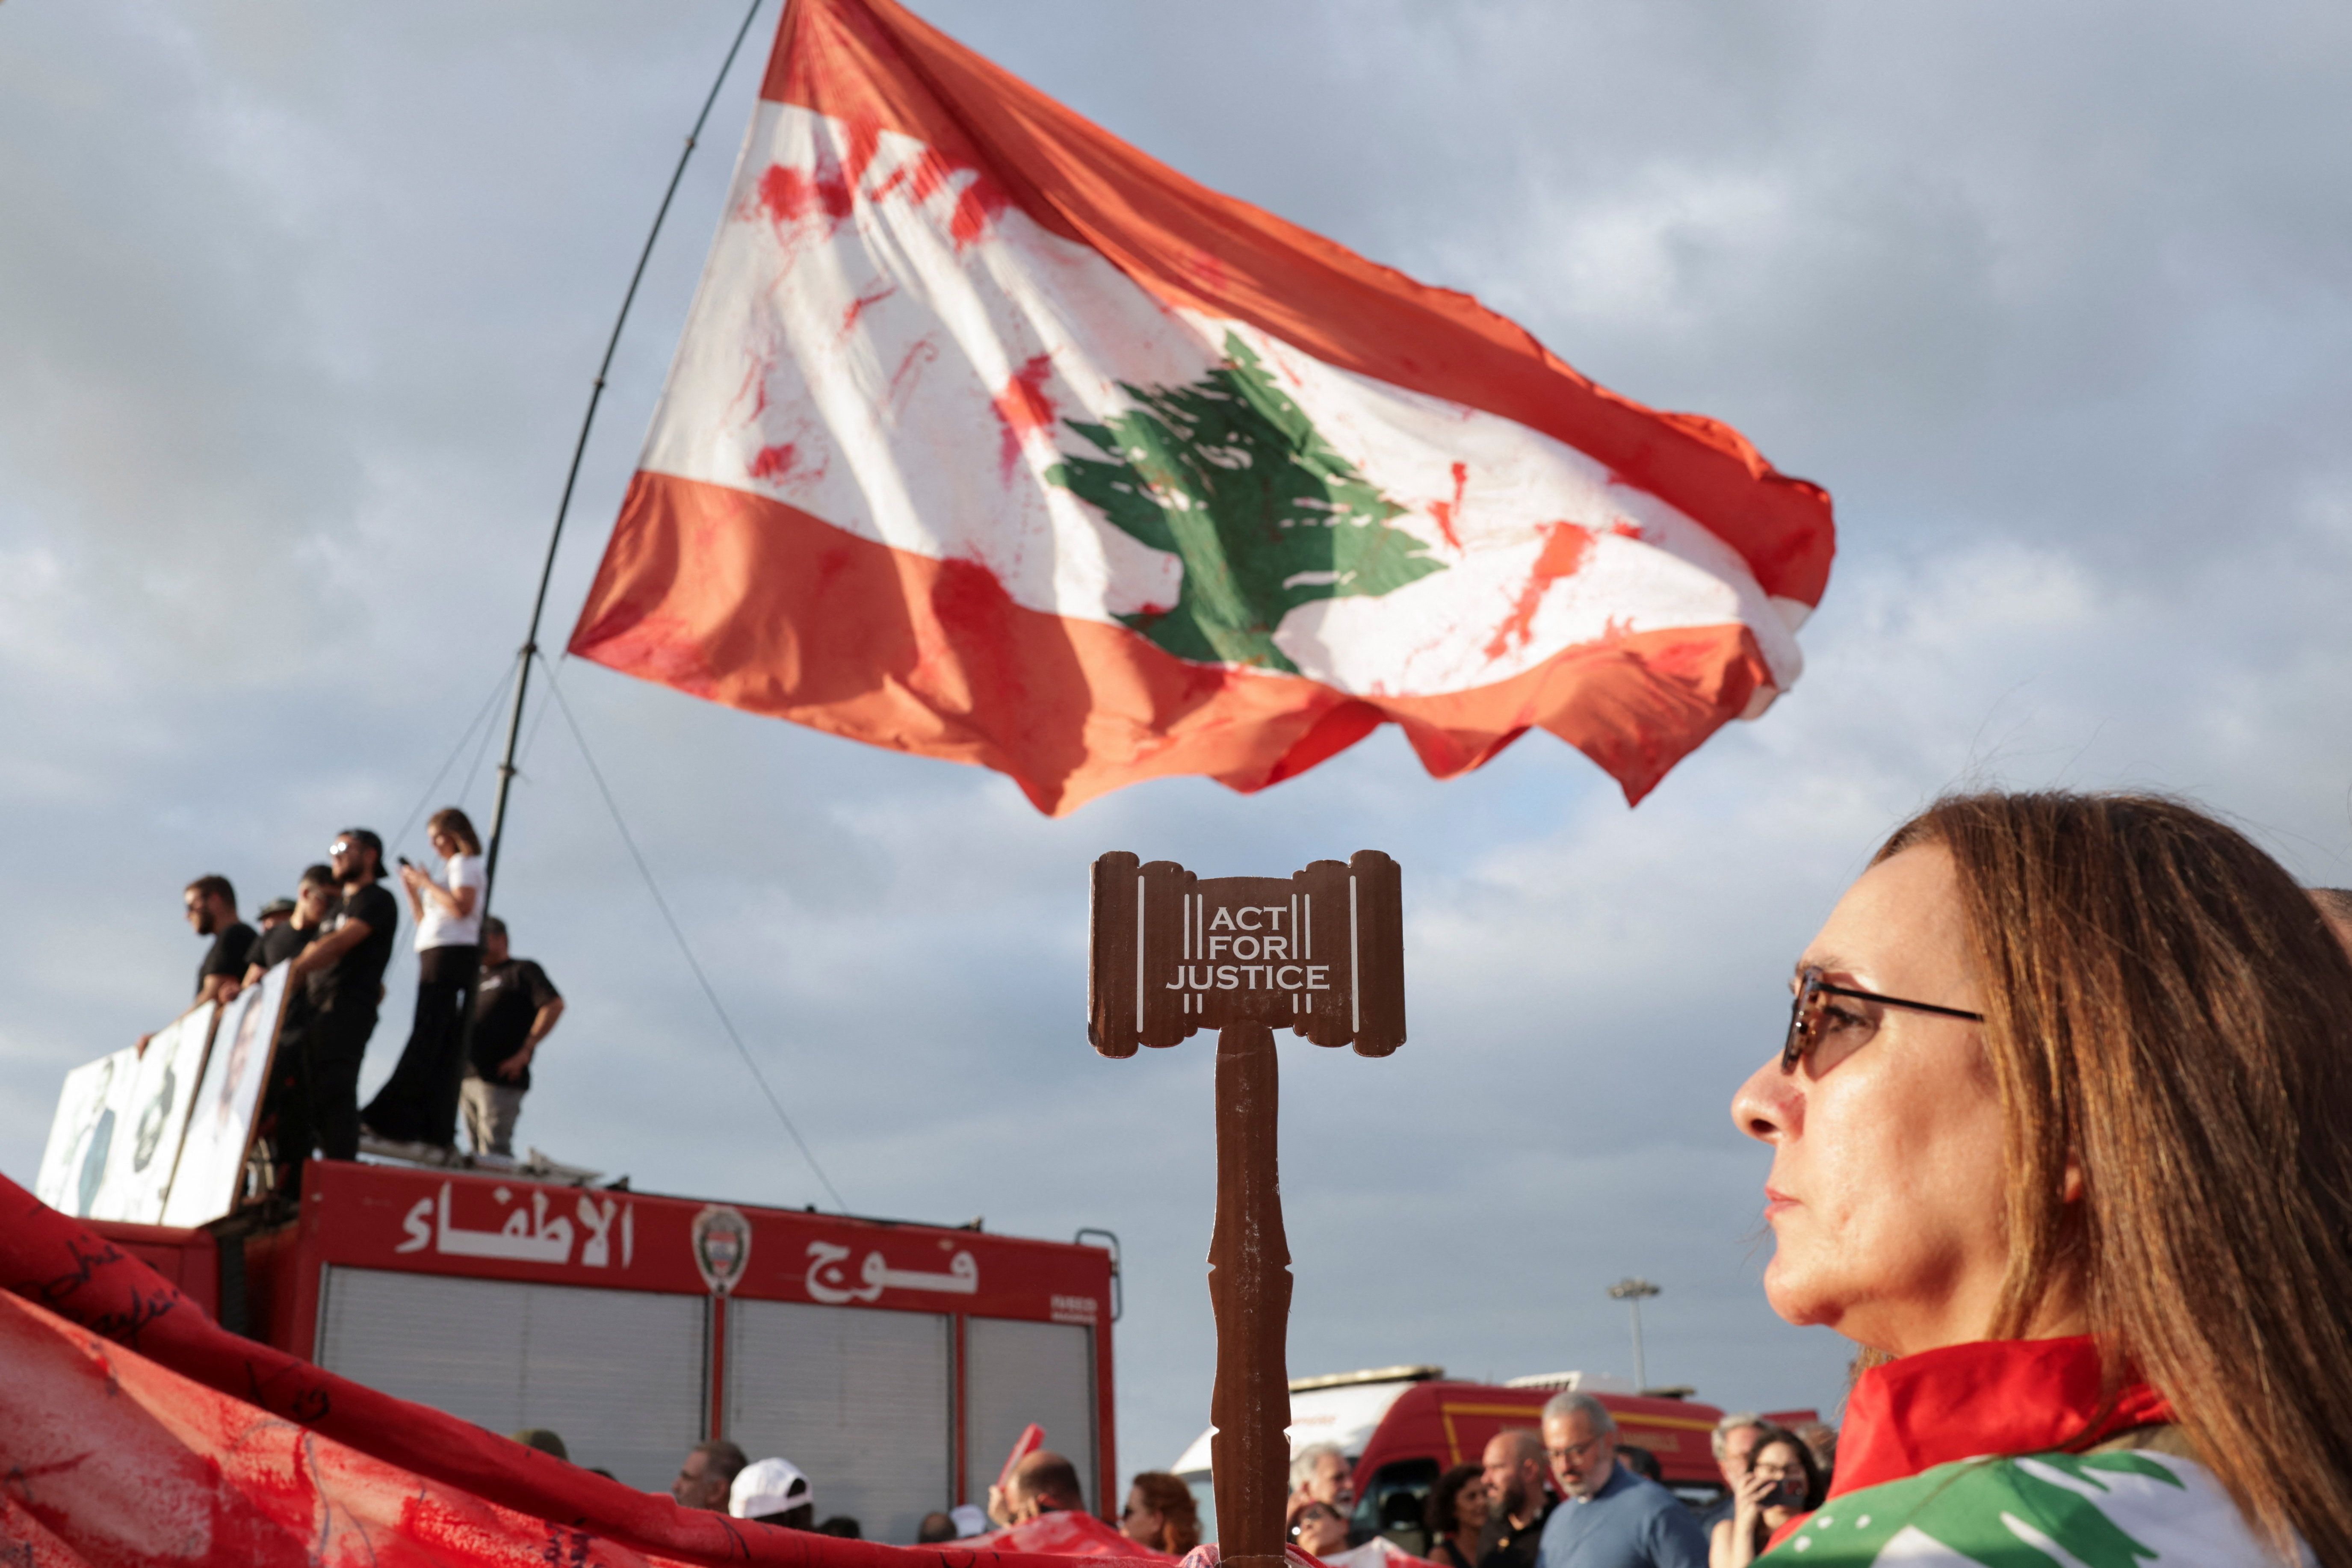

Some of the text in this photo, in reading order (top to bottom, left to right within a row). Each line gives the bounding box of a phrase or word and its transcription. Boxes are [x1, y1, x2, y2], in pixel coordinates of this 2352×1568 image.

[1209, 906, 1288, 930] ACT
[1209, 936, 1288, 960] FOR
[1165, 965, 1330, 990] JUSTICE
[805, 1239, 979, 1304] فوج
